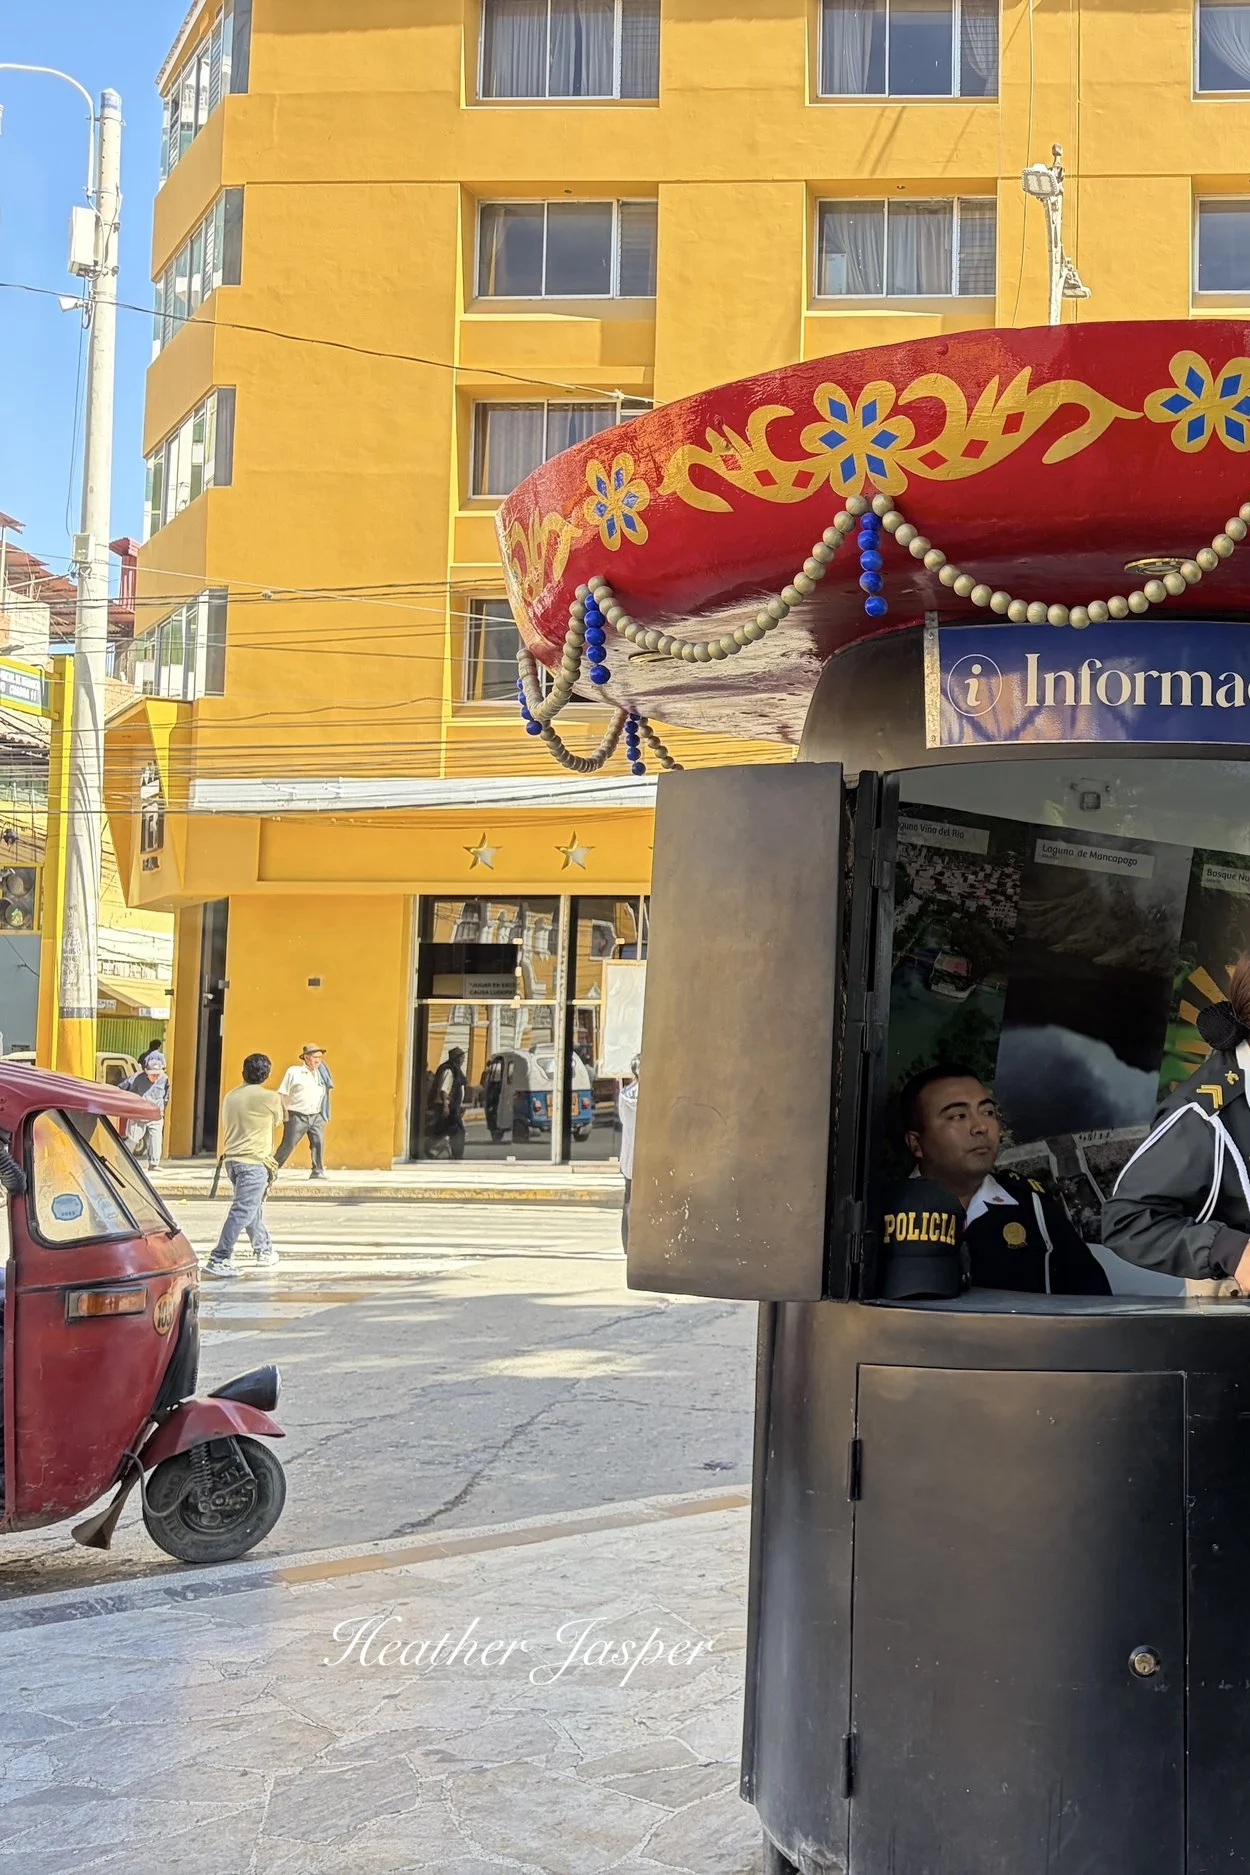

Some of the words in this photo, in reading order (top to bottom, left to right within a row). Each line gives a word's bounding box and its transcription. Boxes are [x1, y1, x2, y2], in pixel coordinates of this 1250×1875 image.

[938, 827, 950, 837] del
[1042, 844, 1074, 857] Laguna
[1077, 849, 1088, 858] de
[1206, 868, 1237, 881] Bosque
[883, 1211, 957, 1246] POLICIA
